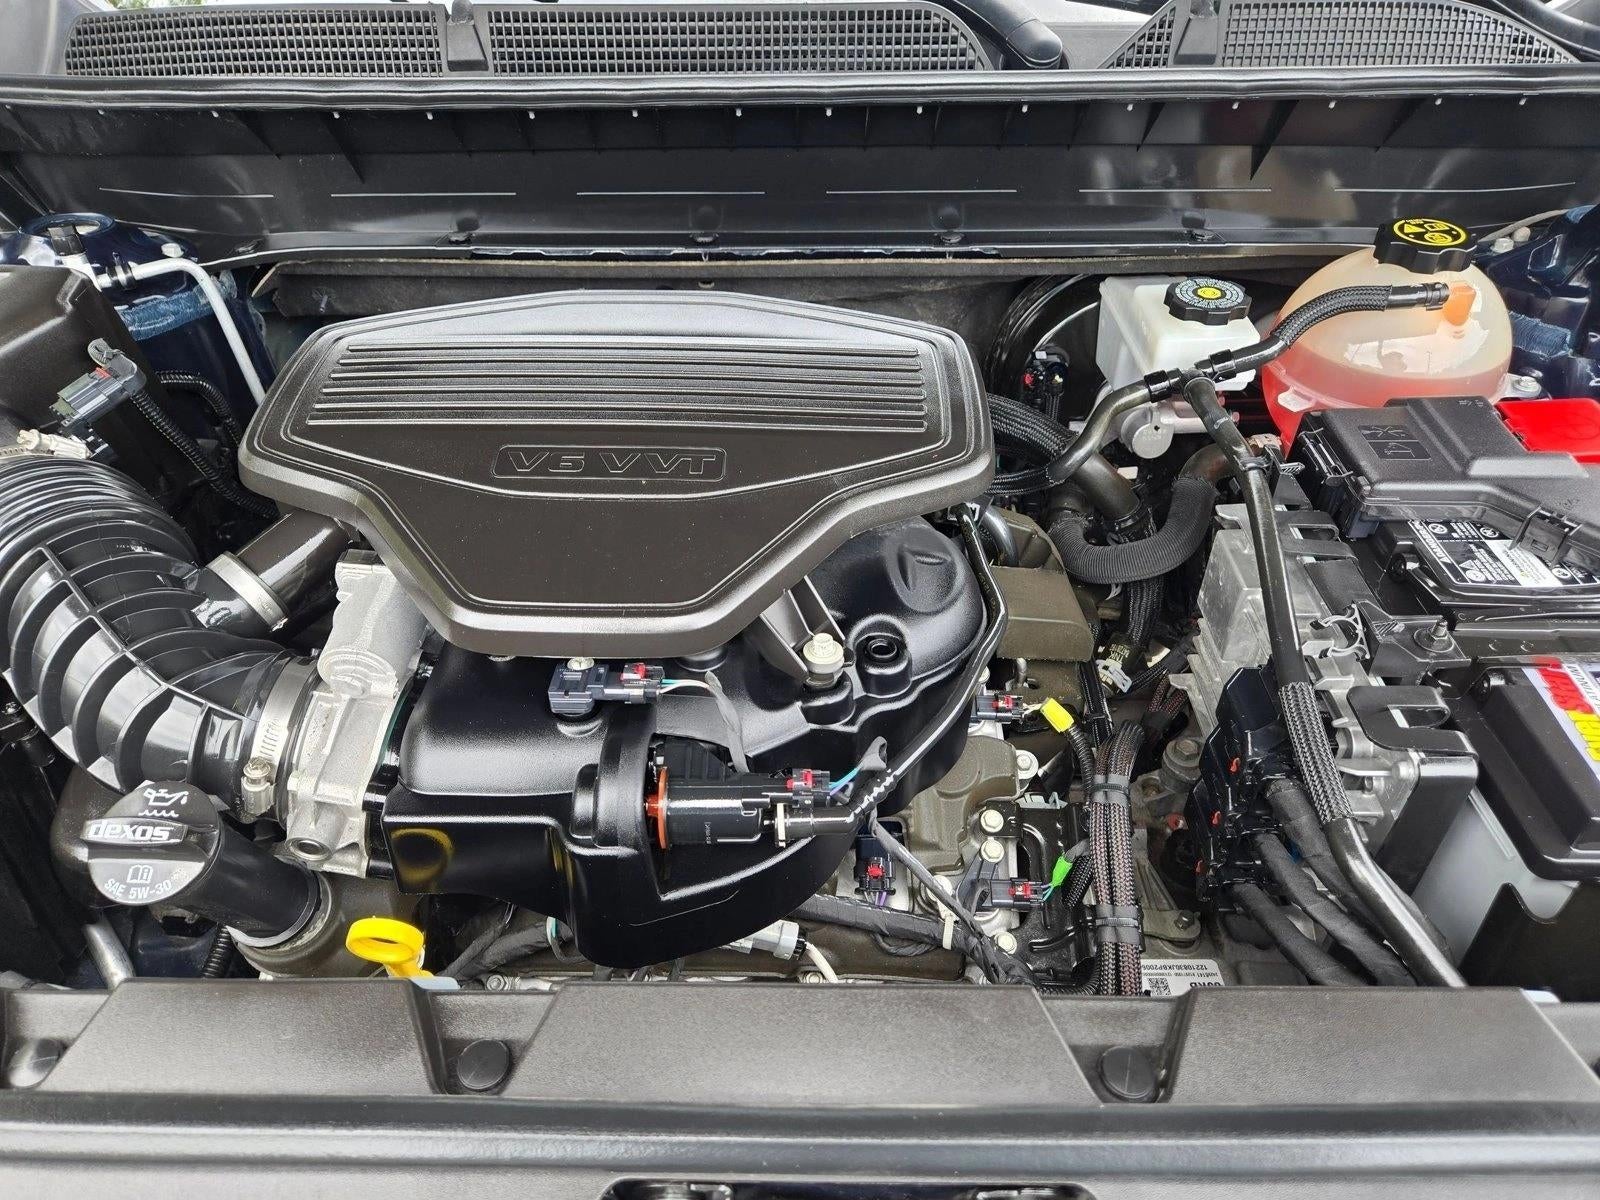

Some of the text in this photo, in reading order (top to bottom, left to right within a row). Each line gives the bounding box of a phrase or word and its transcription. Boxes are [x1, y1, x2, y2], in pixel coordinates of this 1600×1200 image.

[507, 451, 717, 475] V6 VVT
[88, 820, 174, 841] dexos
[104, 878, 173, 900] SAE 5W-30
